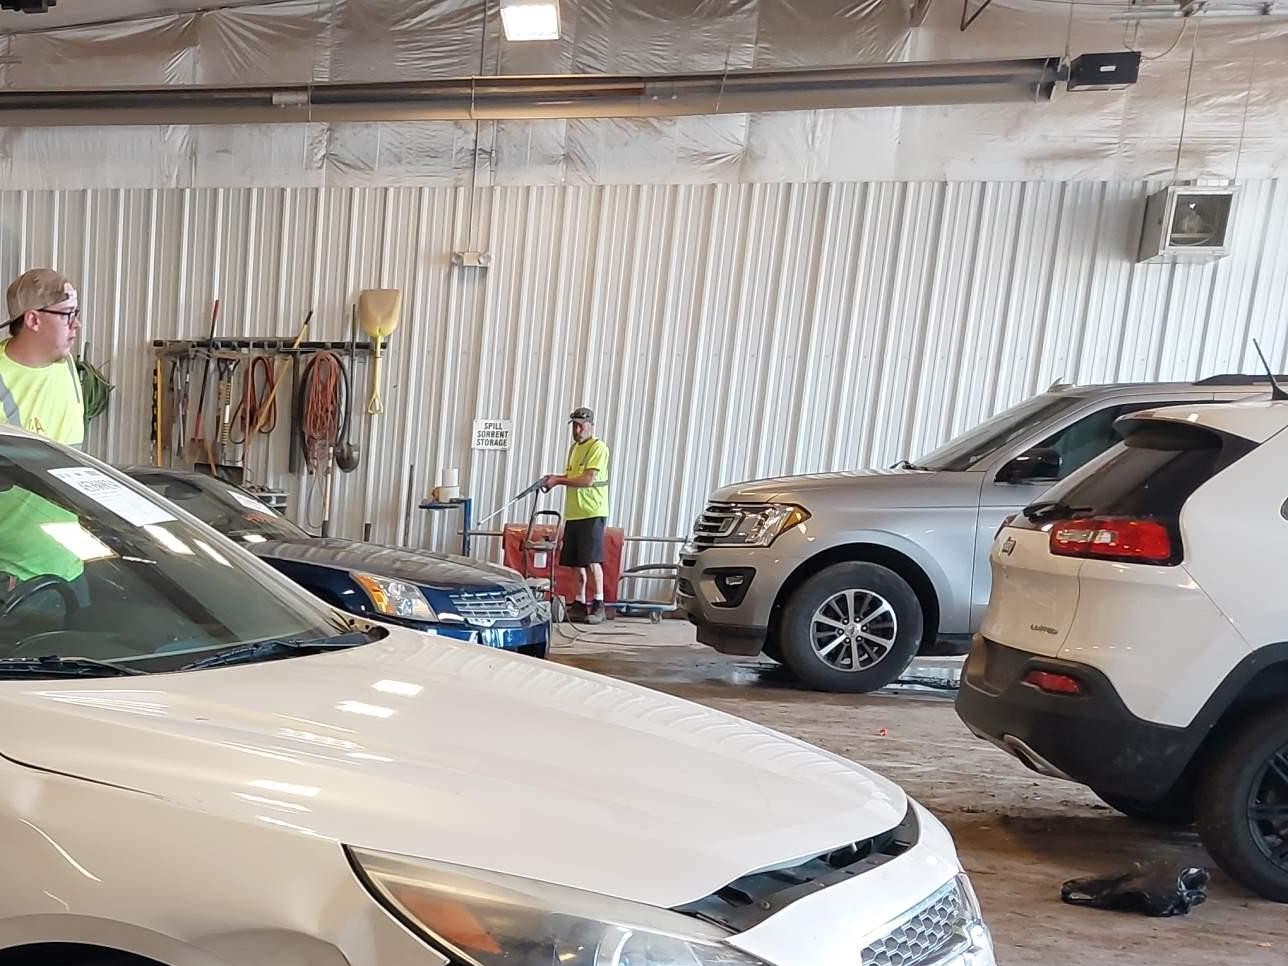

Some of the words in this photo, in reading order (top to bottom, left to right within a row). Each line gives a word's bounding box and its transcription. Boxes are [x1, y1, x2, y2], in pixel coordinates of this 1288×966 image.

[484, 422, 503, 430] SPILL
[477, 430, 509, 438] SORBENT
[476, 438, 508, 447] STORAGE
